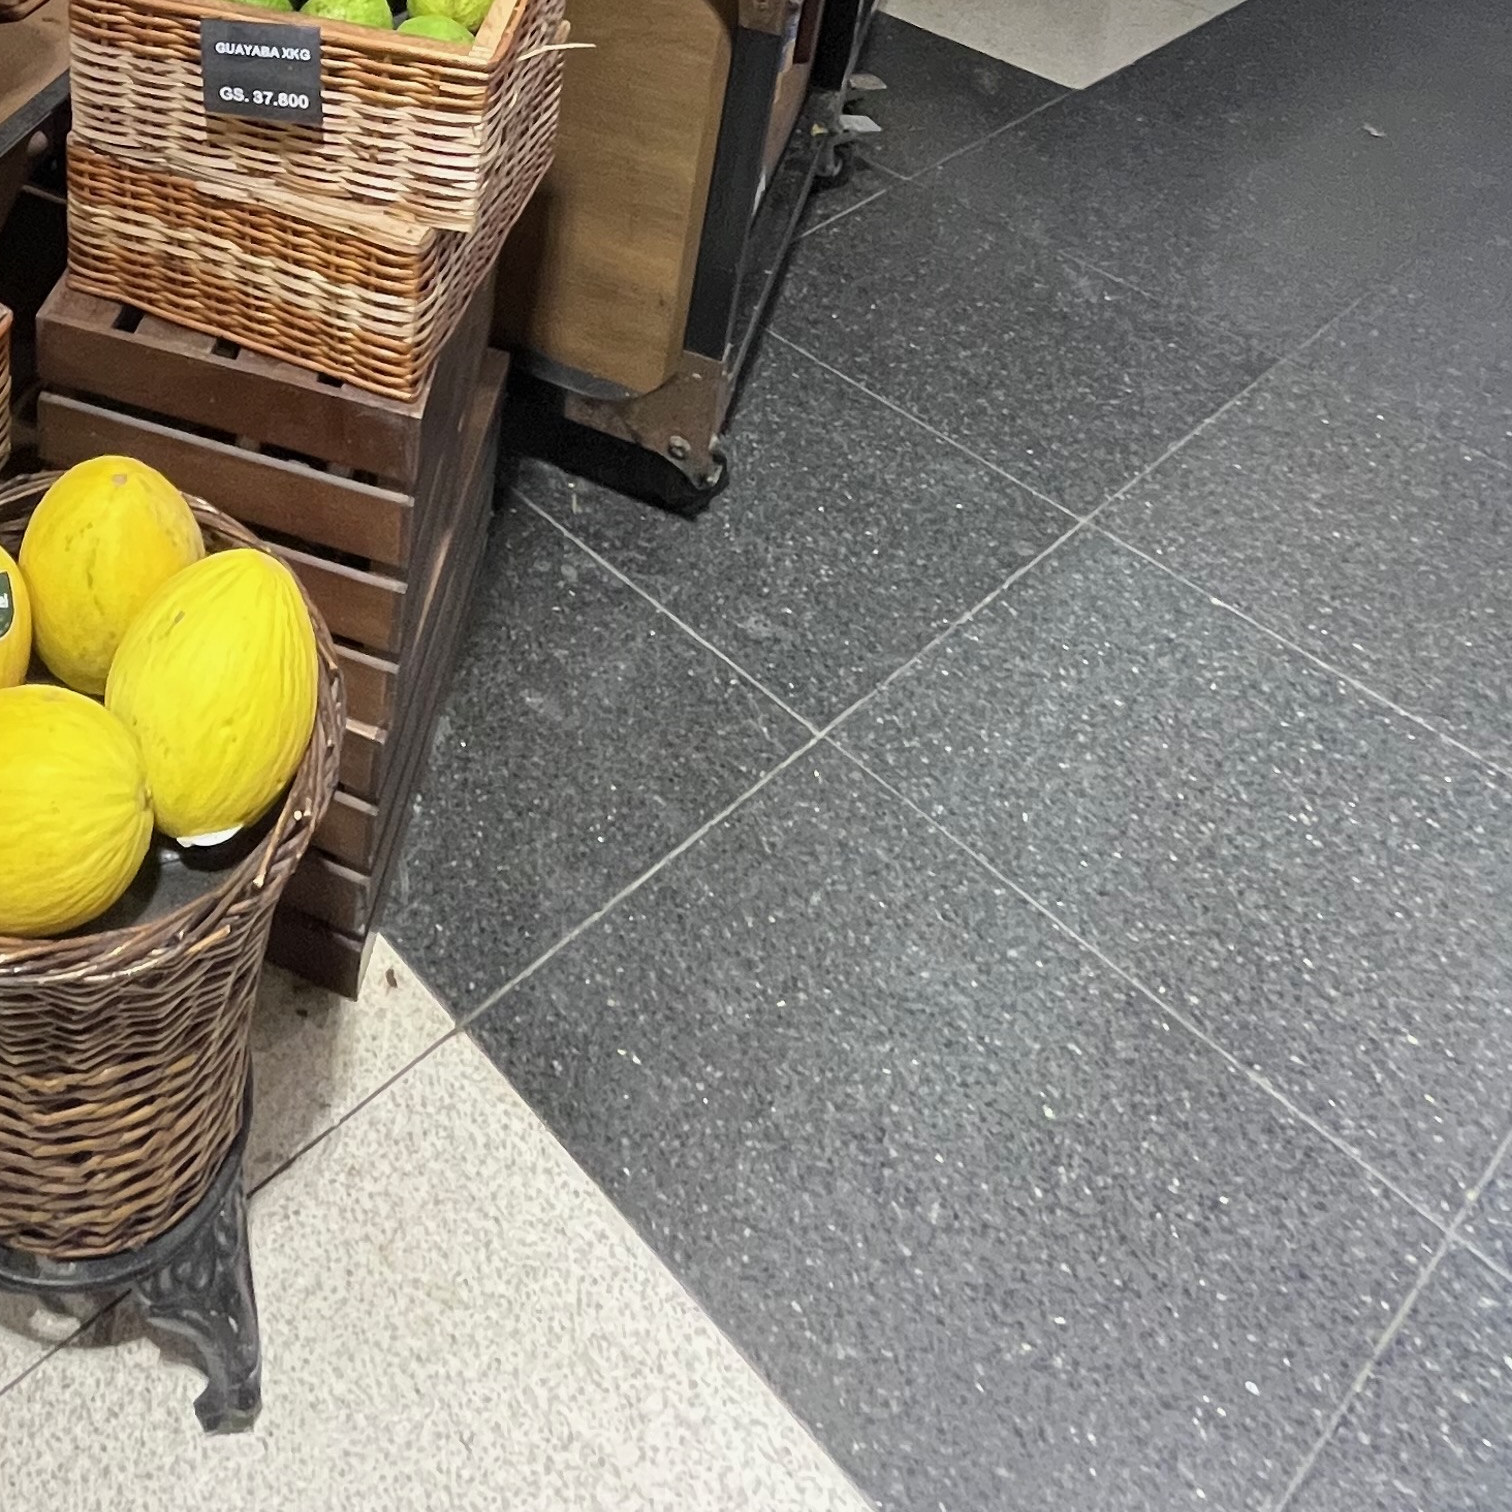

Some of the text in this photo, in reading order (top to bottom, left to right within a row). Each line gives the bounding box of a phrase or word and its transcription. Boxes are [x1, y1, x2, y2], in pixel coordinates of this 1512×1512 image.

[215, 42, 311, 61] GUAYABA XKG
[219, 86, 309, 109] GS. 37.800
